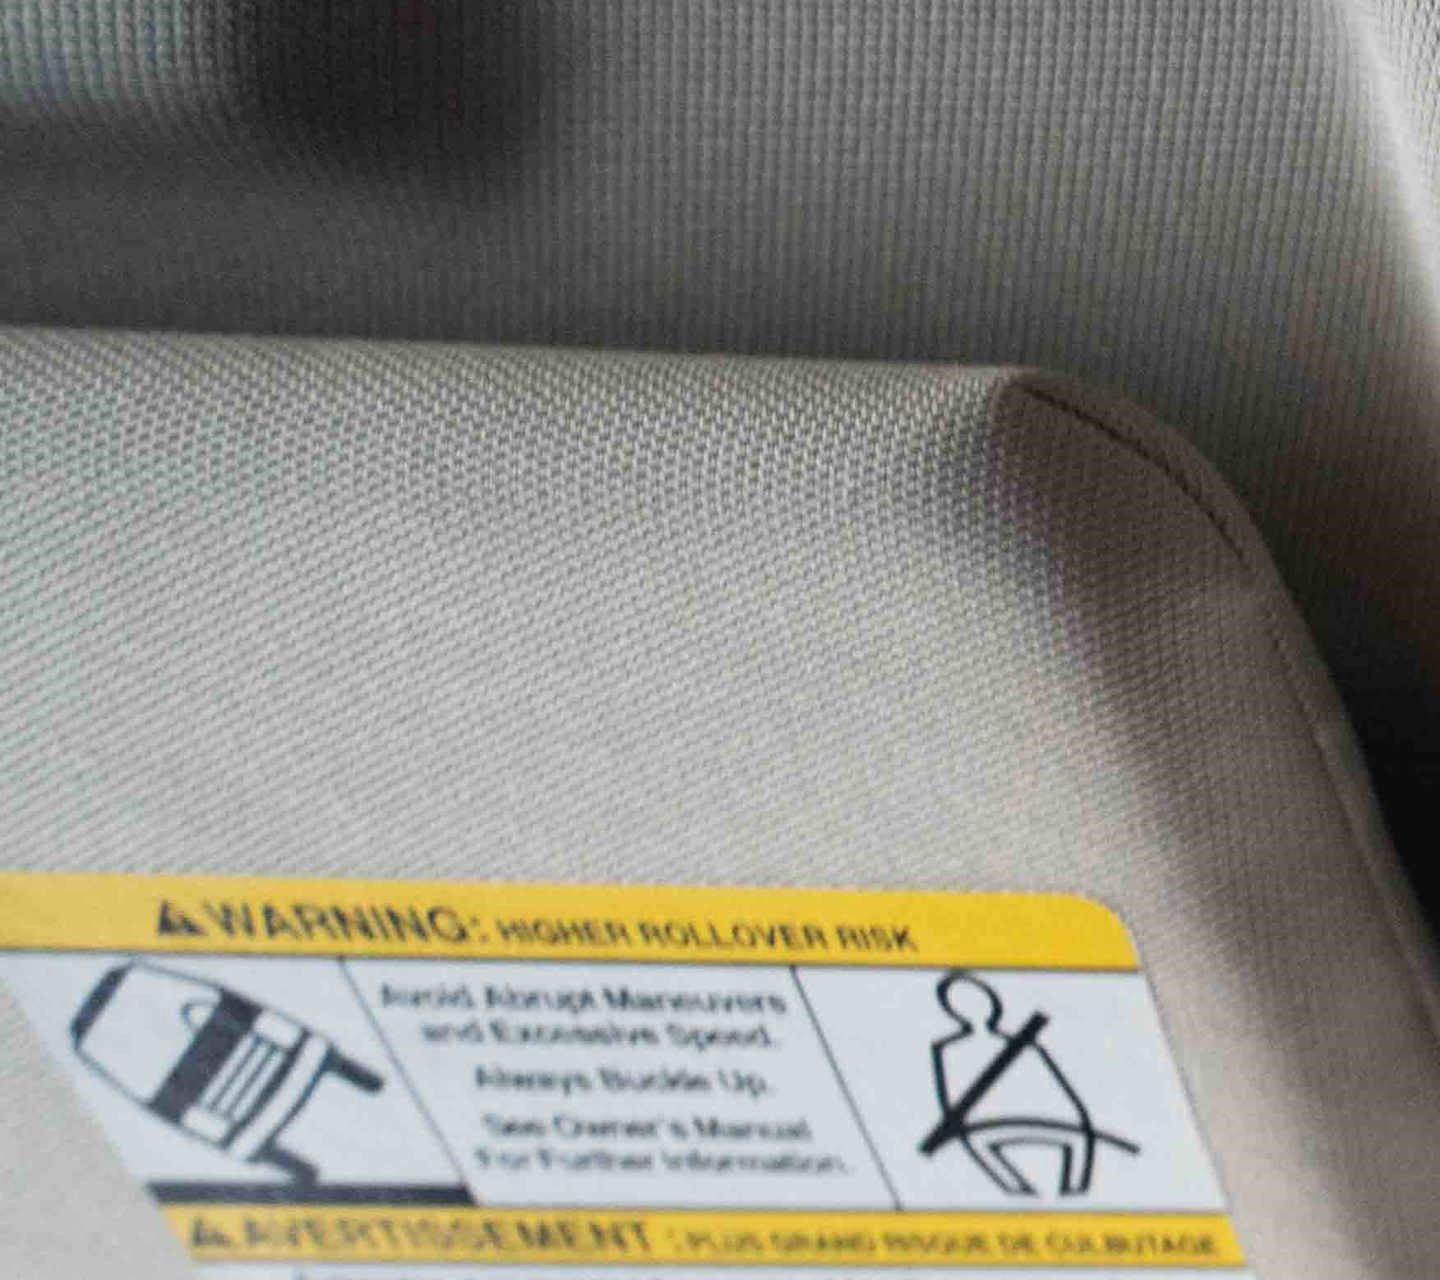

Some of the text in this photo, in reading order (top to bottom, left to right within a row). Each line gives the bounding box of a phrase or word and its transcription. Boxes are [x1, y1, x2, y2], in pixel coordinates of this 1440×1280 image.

[202, 900, 918, 952] WARNING: HIGHER ROLLOVER RISK
[599, 985, 788, 1015] Maneuvers
